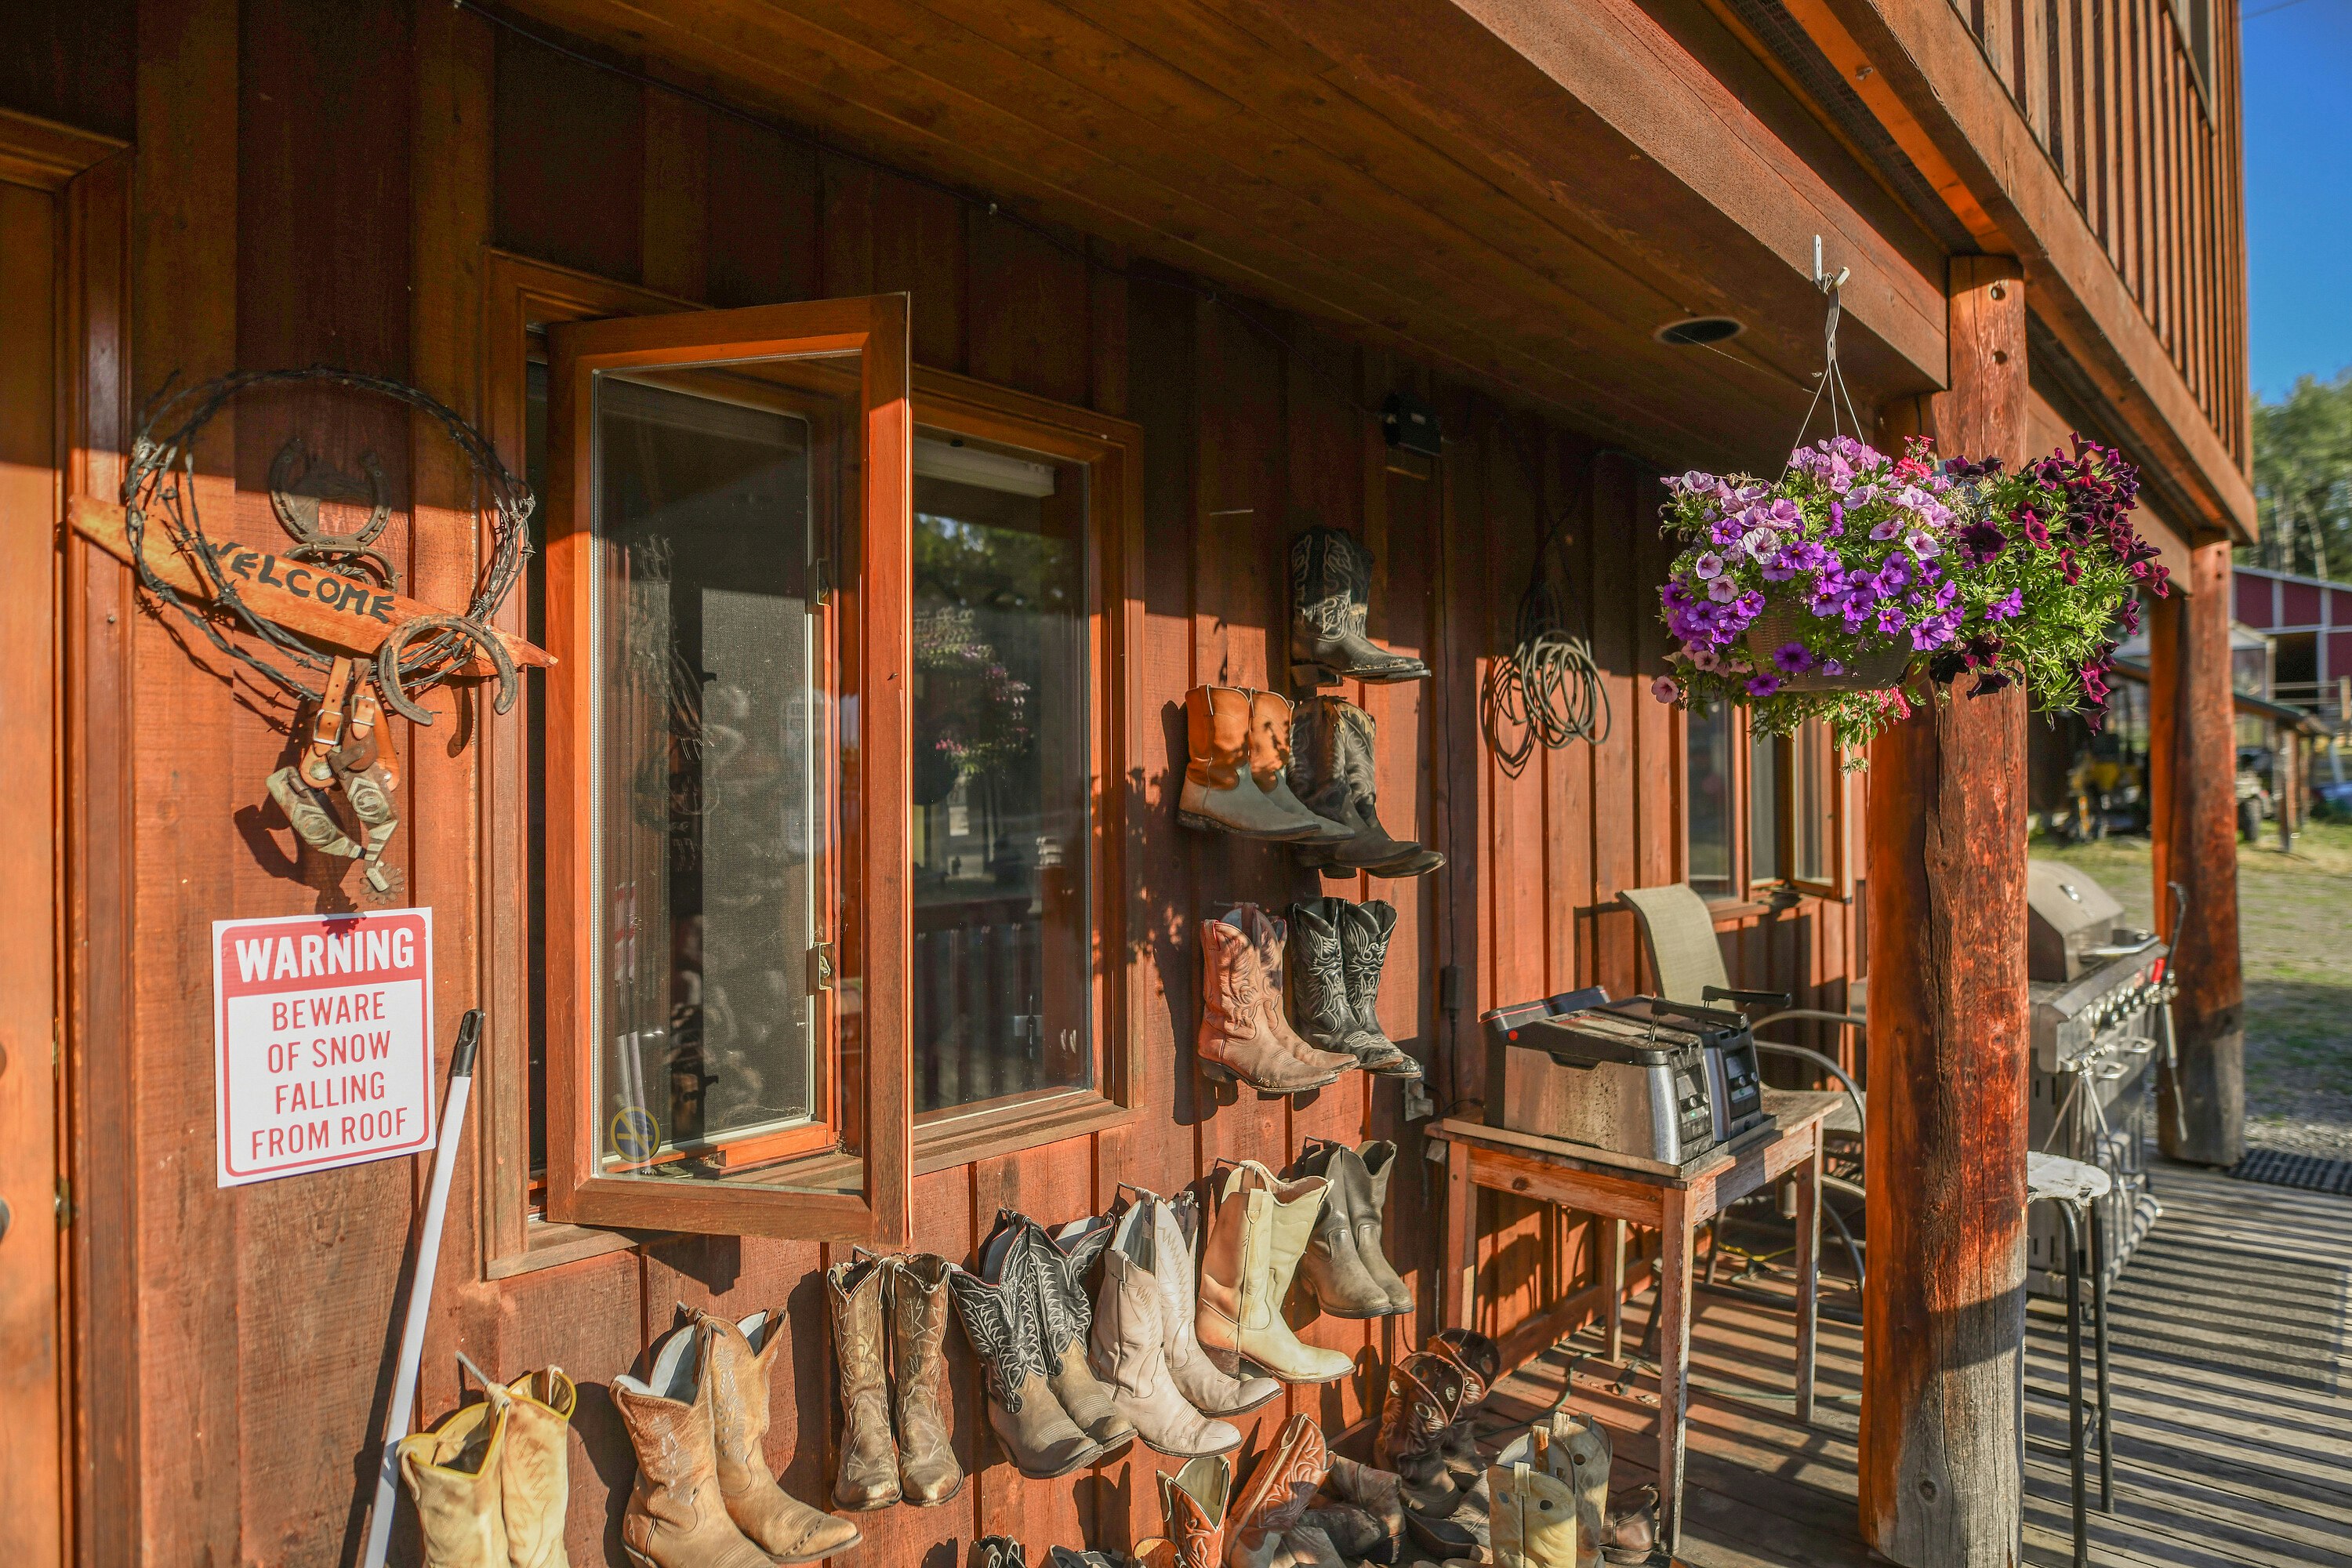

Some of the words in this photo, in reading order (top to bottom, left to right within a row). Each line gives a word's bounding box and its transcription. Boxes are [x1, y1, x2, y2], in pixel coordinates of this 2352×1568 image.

[234, 927, 415, 982] WARNING
[272, 991, 386, 1031] BEWARE
[267, 1041, 301, 1074] OF
[312, 1030, 391, 1069] SNOW
[275, 1071, 385, 1115] FALLING
[252, 1120, 329, 1160] FROM
[341, 1107, 408, 1145] ROOF
